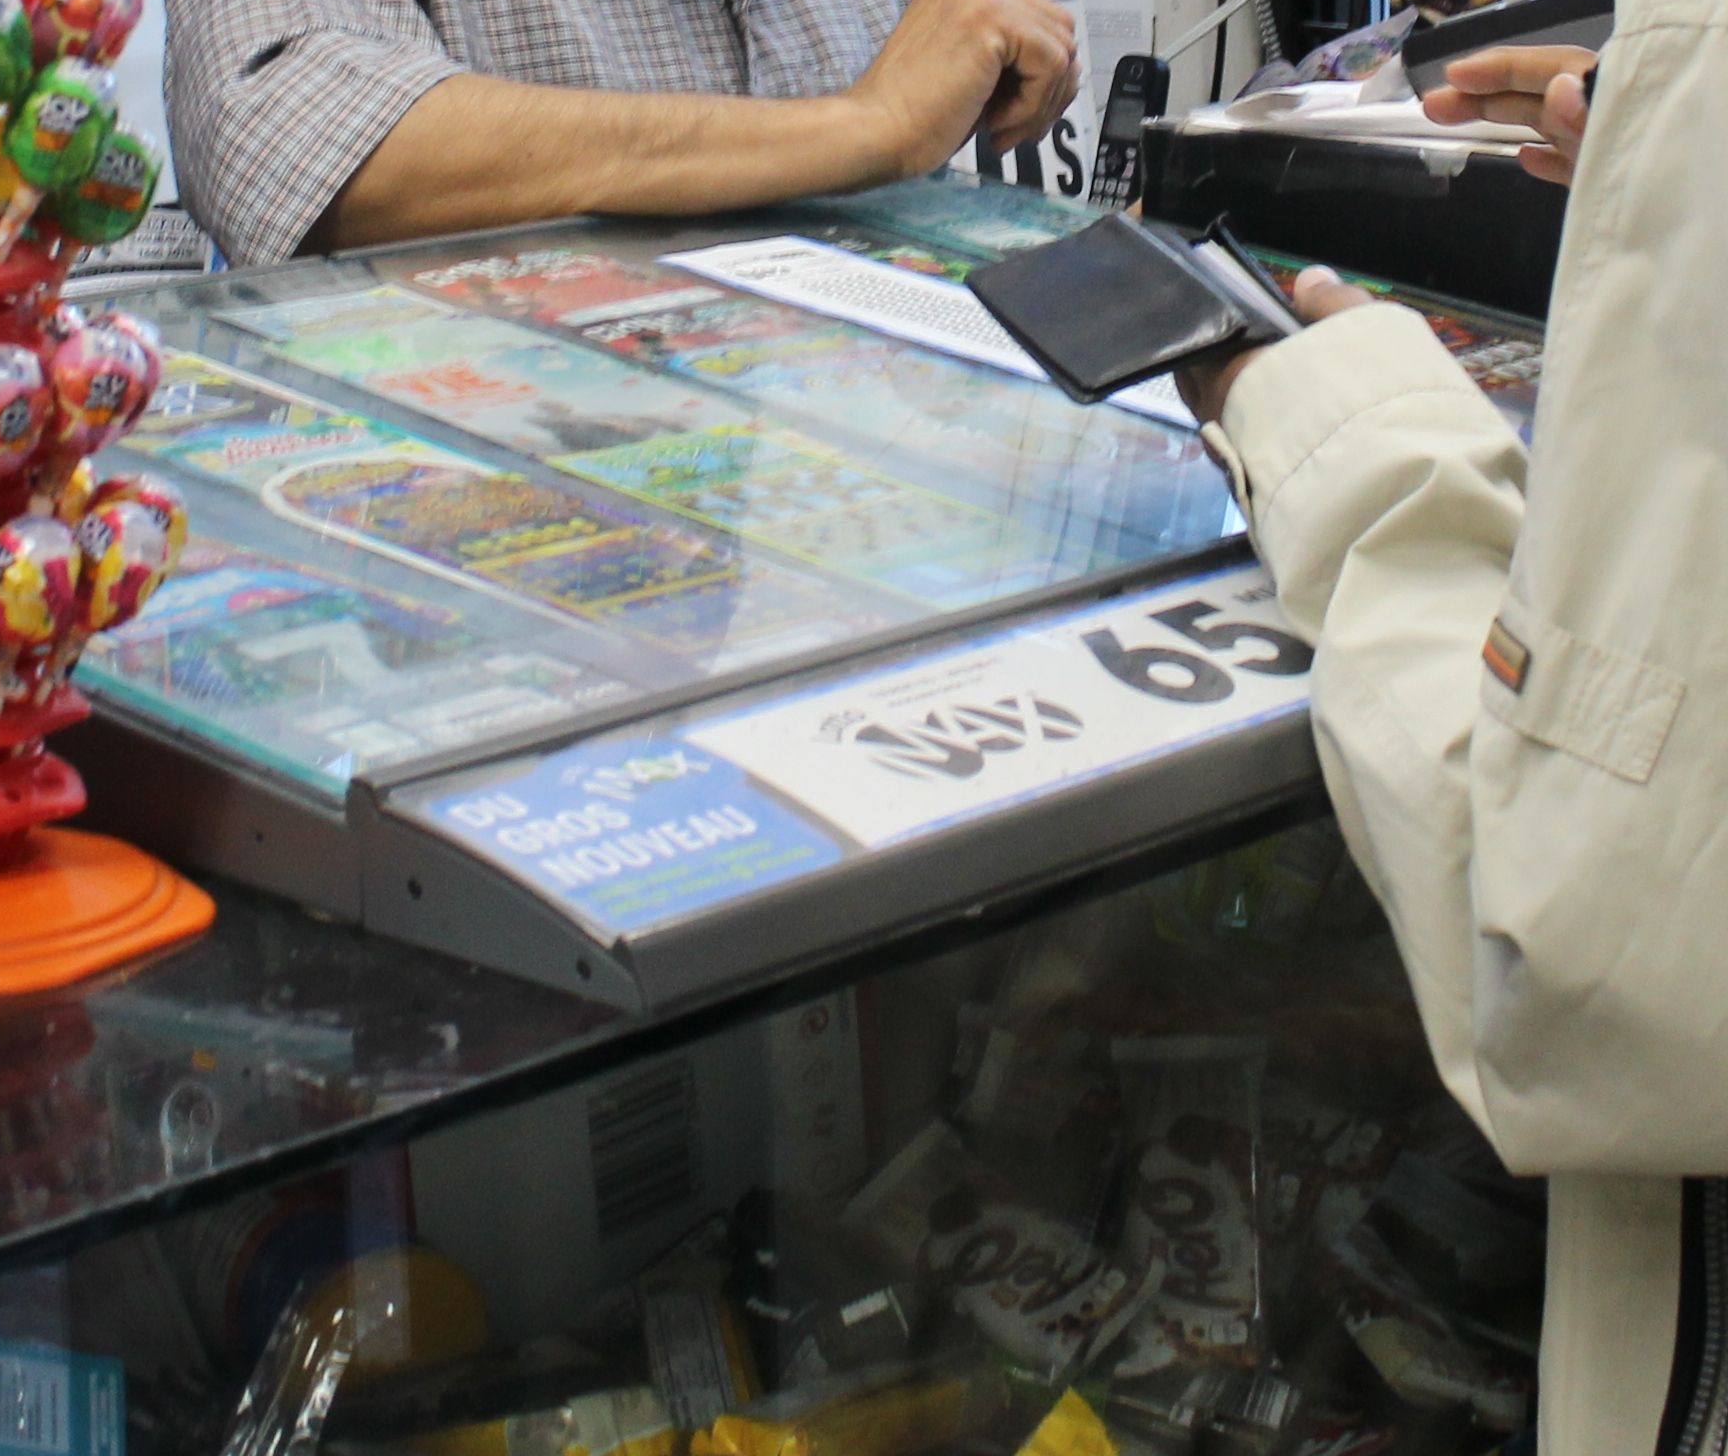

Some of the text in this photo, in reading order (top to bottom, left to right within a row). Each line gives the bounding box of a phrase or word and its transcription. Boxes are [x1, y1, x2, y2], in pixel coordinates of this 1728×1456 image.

[1080, 600, 1315, 706] 65
[855, 692, 1085, 781] MAX
[446, 792, 528, 830] DU
[496, 802, 630, 855] GROS
[540, 804, 758, 888] NOUVEAU
